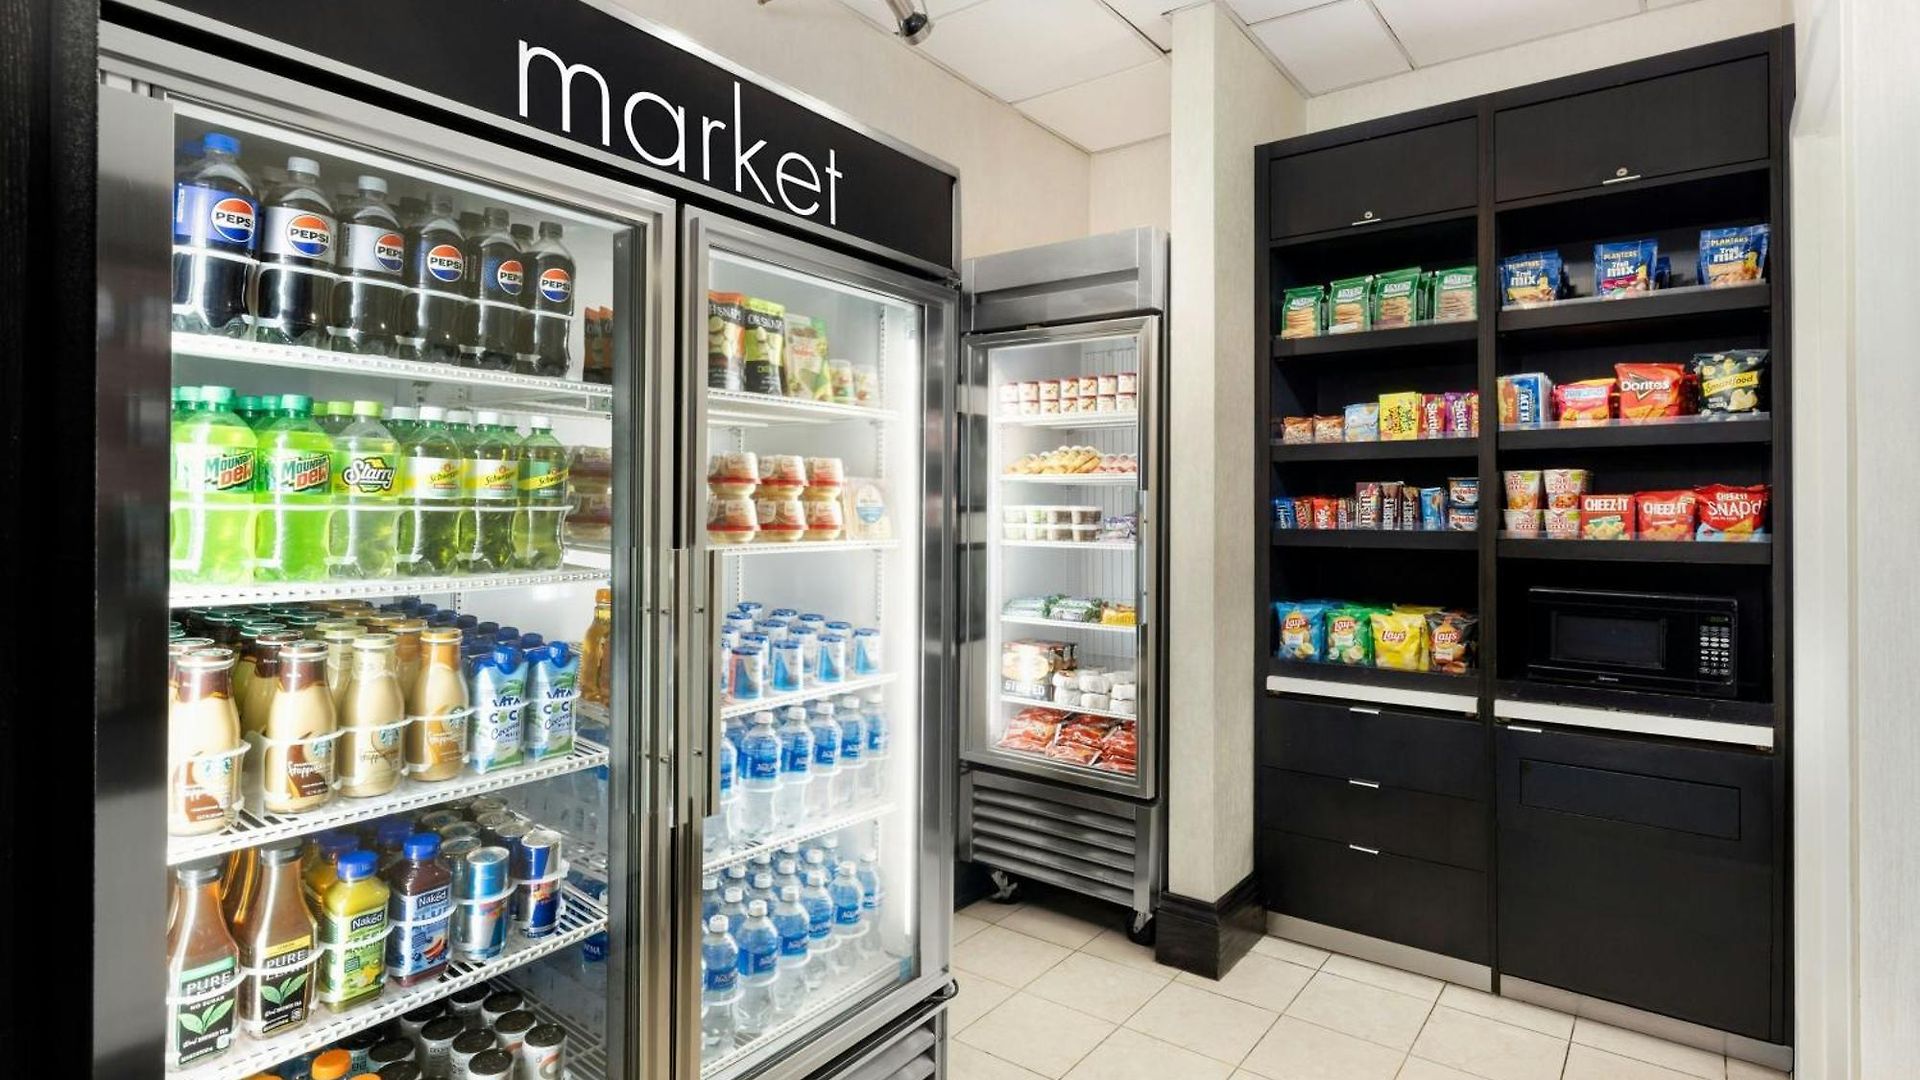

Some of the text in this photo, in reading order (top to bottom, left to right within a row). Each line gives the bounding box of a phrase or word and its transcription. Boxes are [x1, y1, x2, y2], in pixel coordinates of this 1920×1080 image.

[518, 39, 844, 226] market
[290, 228, 329, 244] PEPSI
[542, 279, 570, 292] PEPSI
[1621, 380, 1670, 392] Doritos
[343, 459, 394, 490] Starry
[1585, 498, 1629, 512] CHEEZ-IT
[1643, 501, 1688, 515] CHEEZ-IT
[418, 890, 446, 908] Naked
[352, 911, 383, 930] Naked
[267, 950, 307, 970] PURE
[186, 971, 231, 996] PURE
